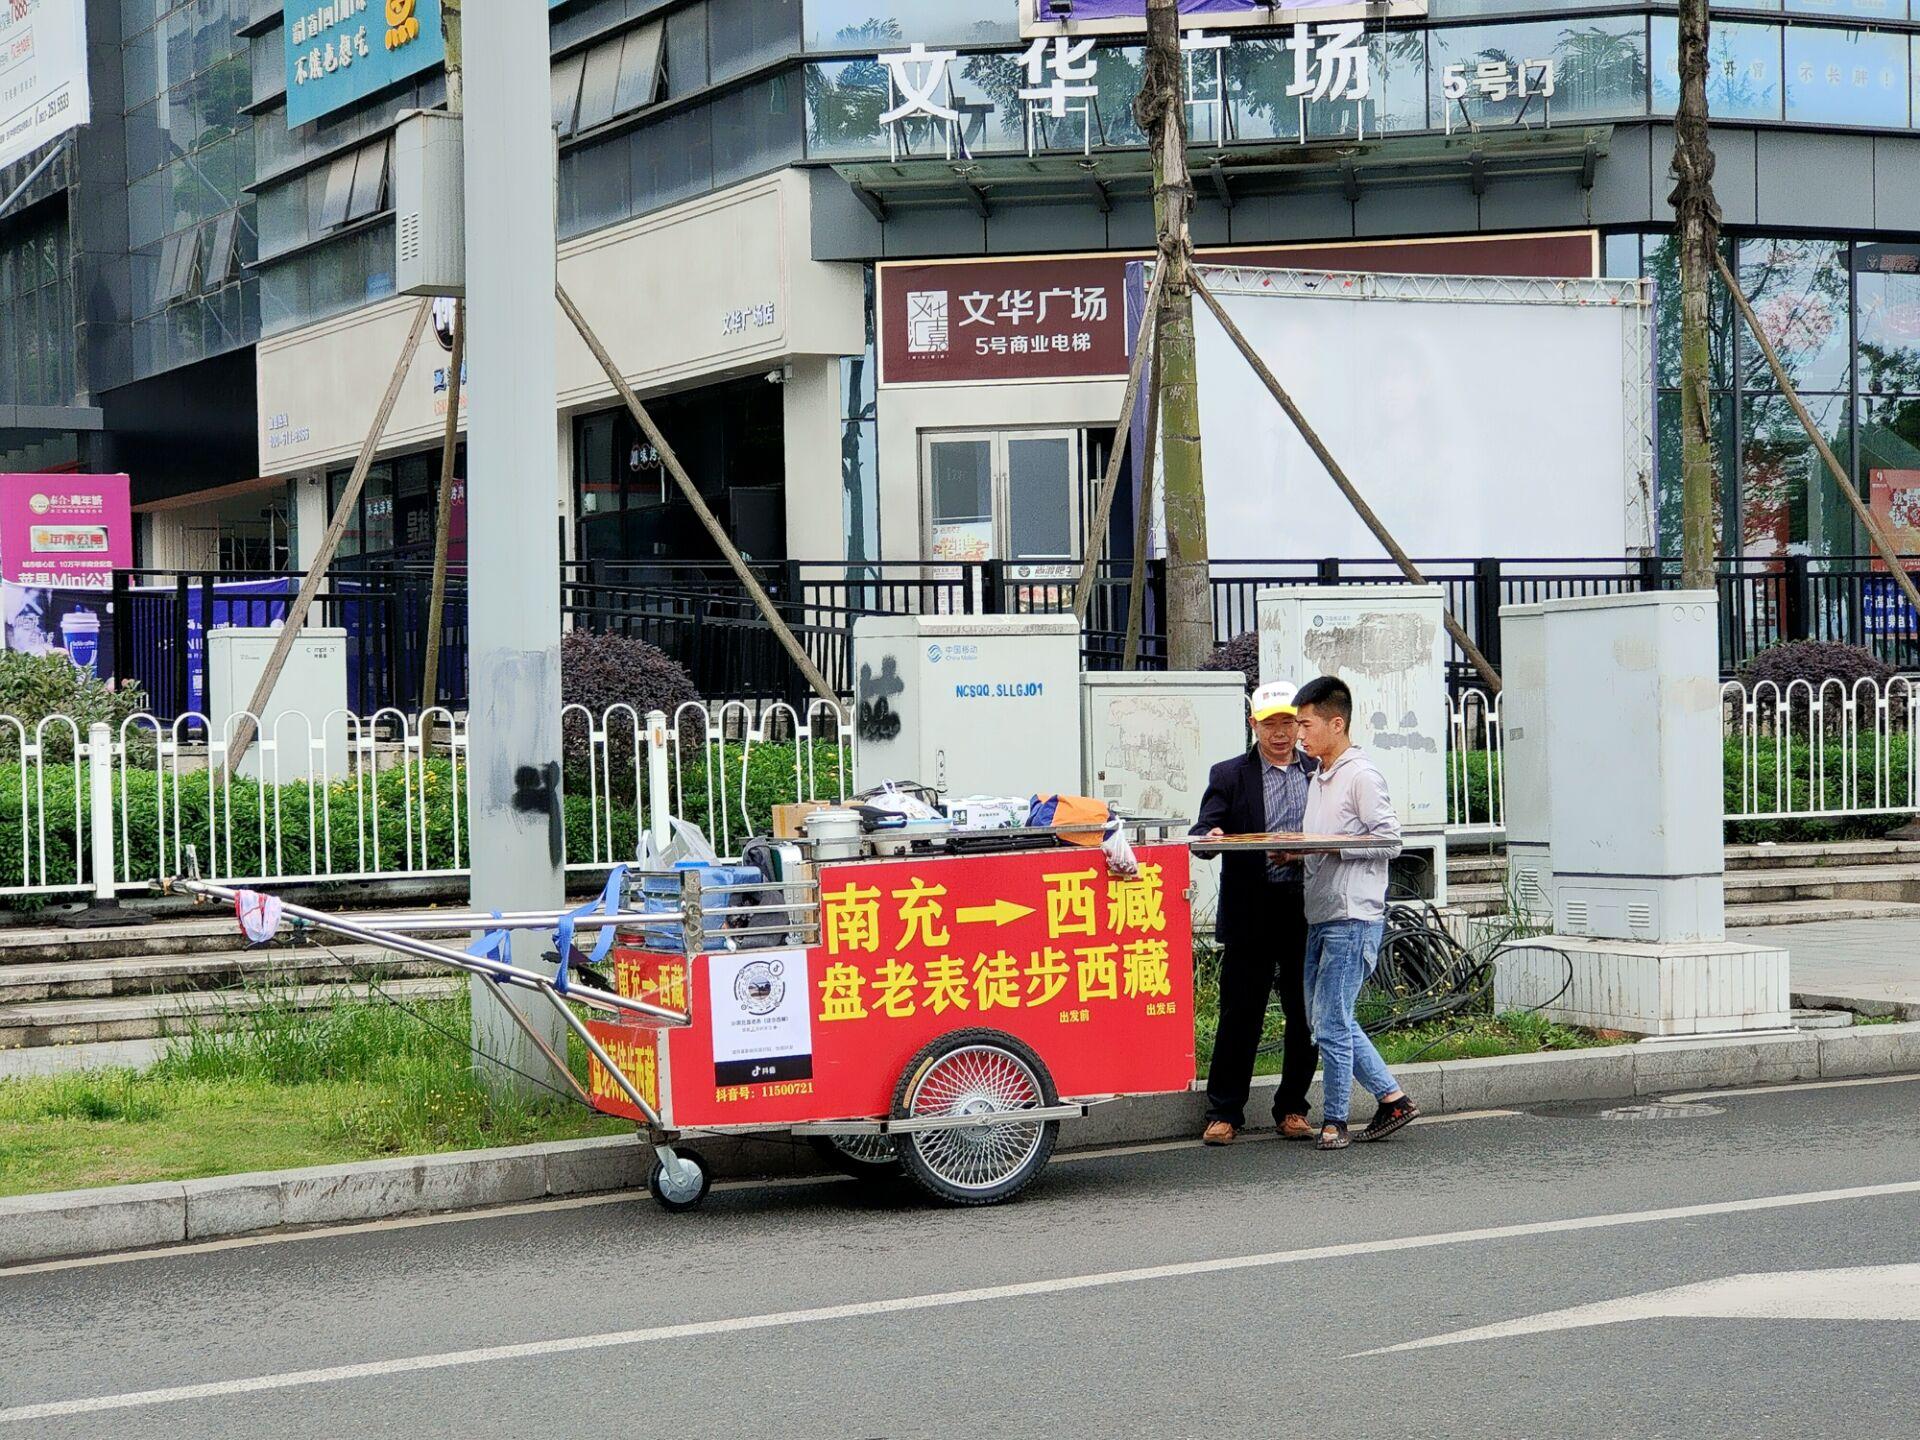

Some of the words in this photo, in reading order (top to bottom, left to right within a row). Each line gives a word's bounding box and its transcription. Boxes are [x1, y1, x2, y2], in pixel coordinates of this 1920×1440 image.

[1442, 58, 1555, 102] 5号门
[958, 286, 1108, 327] 文华广场
[975, 332, 1092, 356] 5号商业电梯
[821, 877, 951, 955] 南充
[1041, 862, 1167, 940] 西藏
[817, 938, 1172, 1022] 盘老表徒步西藏
[1059, 1009, 1090, 1023] 出发前
[1146, 1002, 1177, 1016] 出发后
